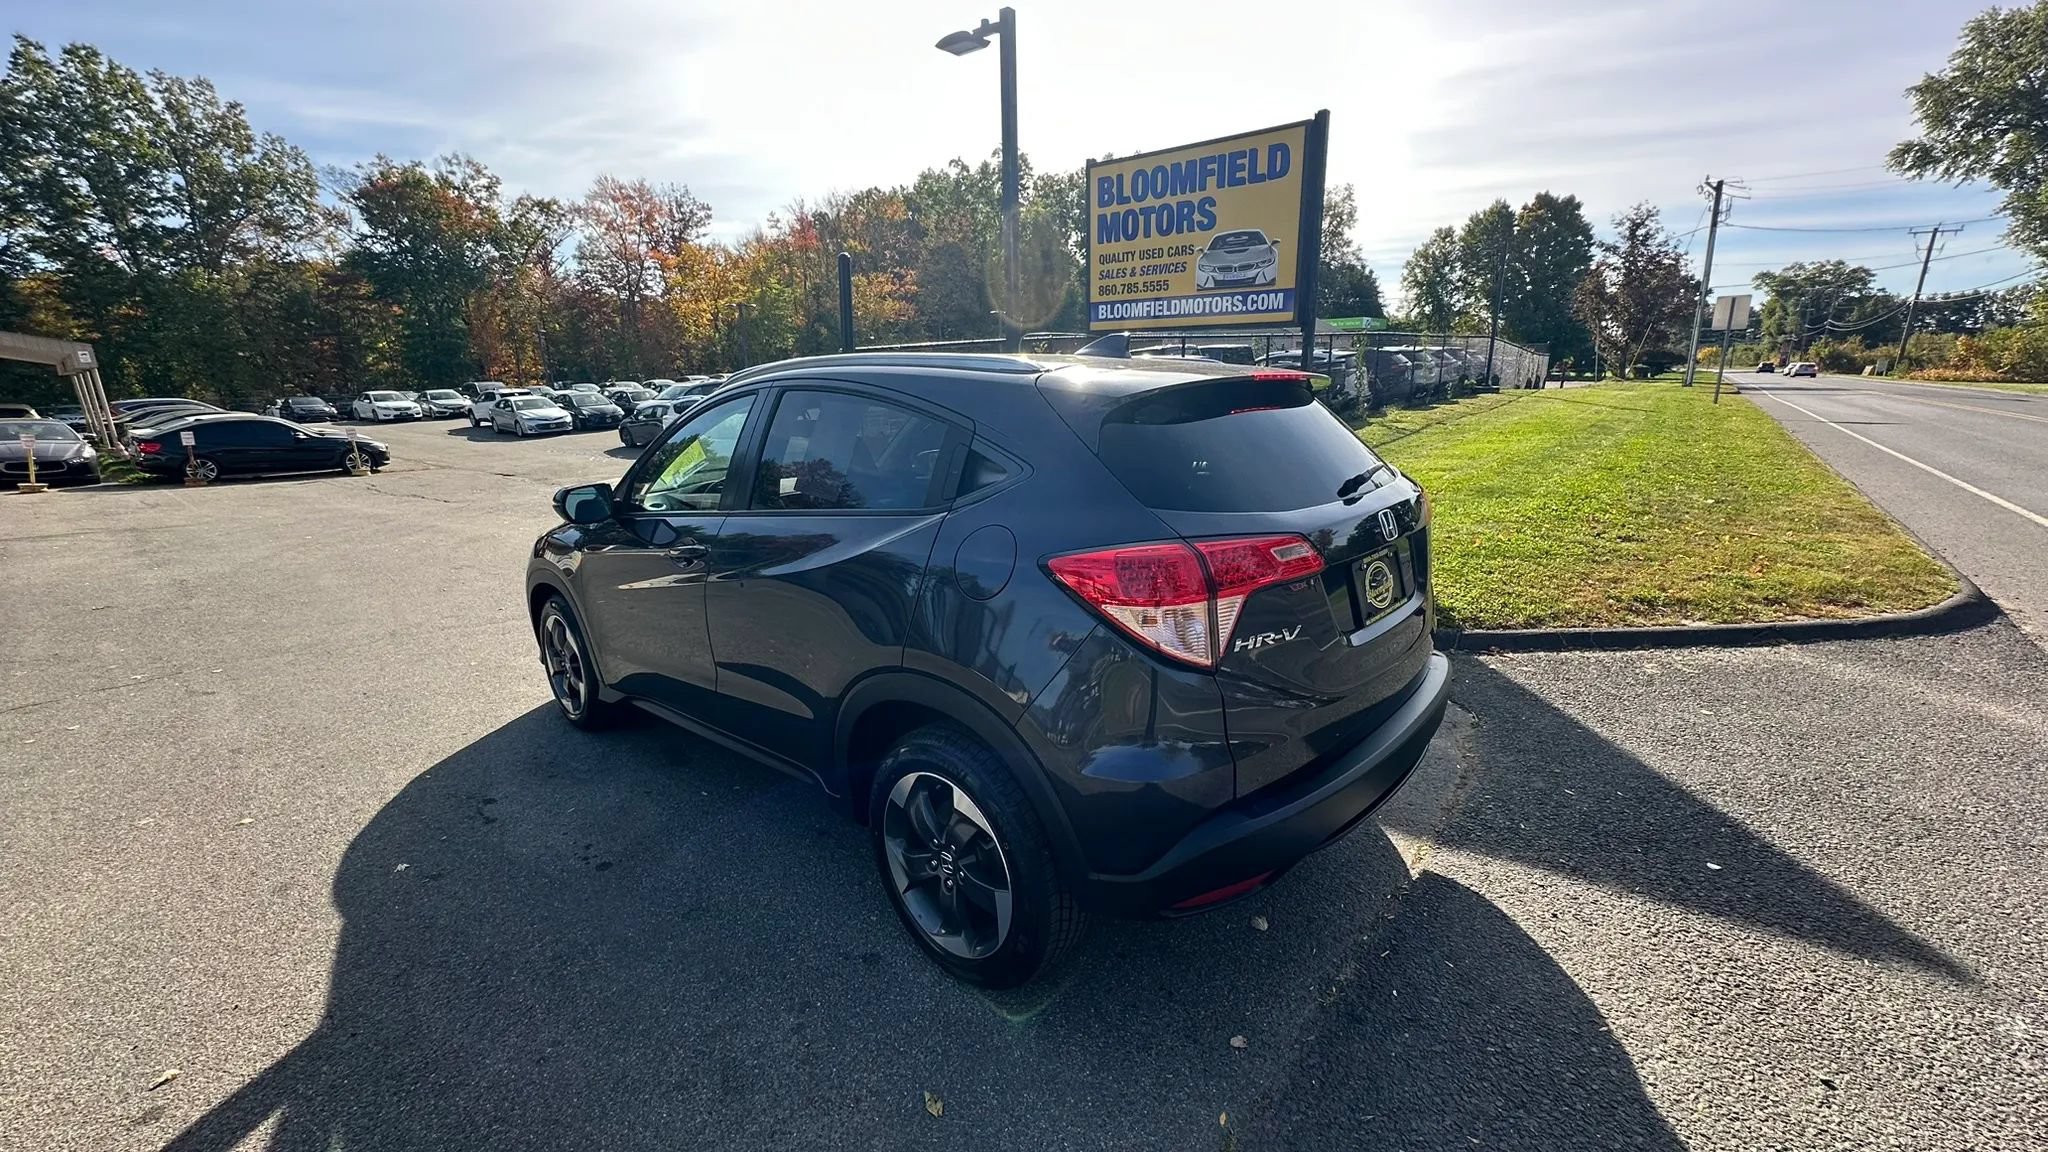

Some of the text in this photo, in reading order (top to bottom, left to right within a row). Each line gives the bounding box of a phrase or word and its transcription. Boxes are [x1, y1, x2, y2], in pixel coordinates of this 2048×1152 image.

[1097, 142, 1291, 209] BLOOMFIELD
[1097, 196, 1217, 244] MOTORS
[1099, 244, 1195, 265] QUALITY USED CARS
[1099, 261, 1188, 280] SALES & SERVICES
[1098, 279, 1170, 296] 860.785.5555
[1098, 292, 1284, 319] BLOOMFIELDMOTORS.COM
[1233, 624, 1302, 653] HR-V
